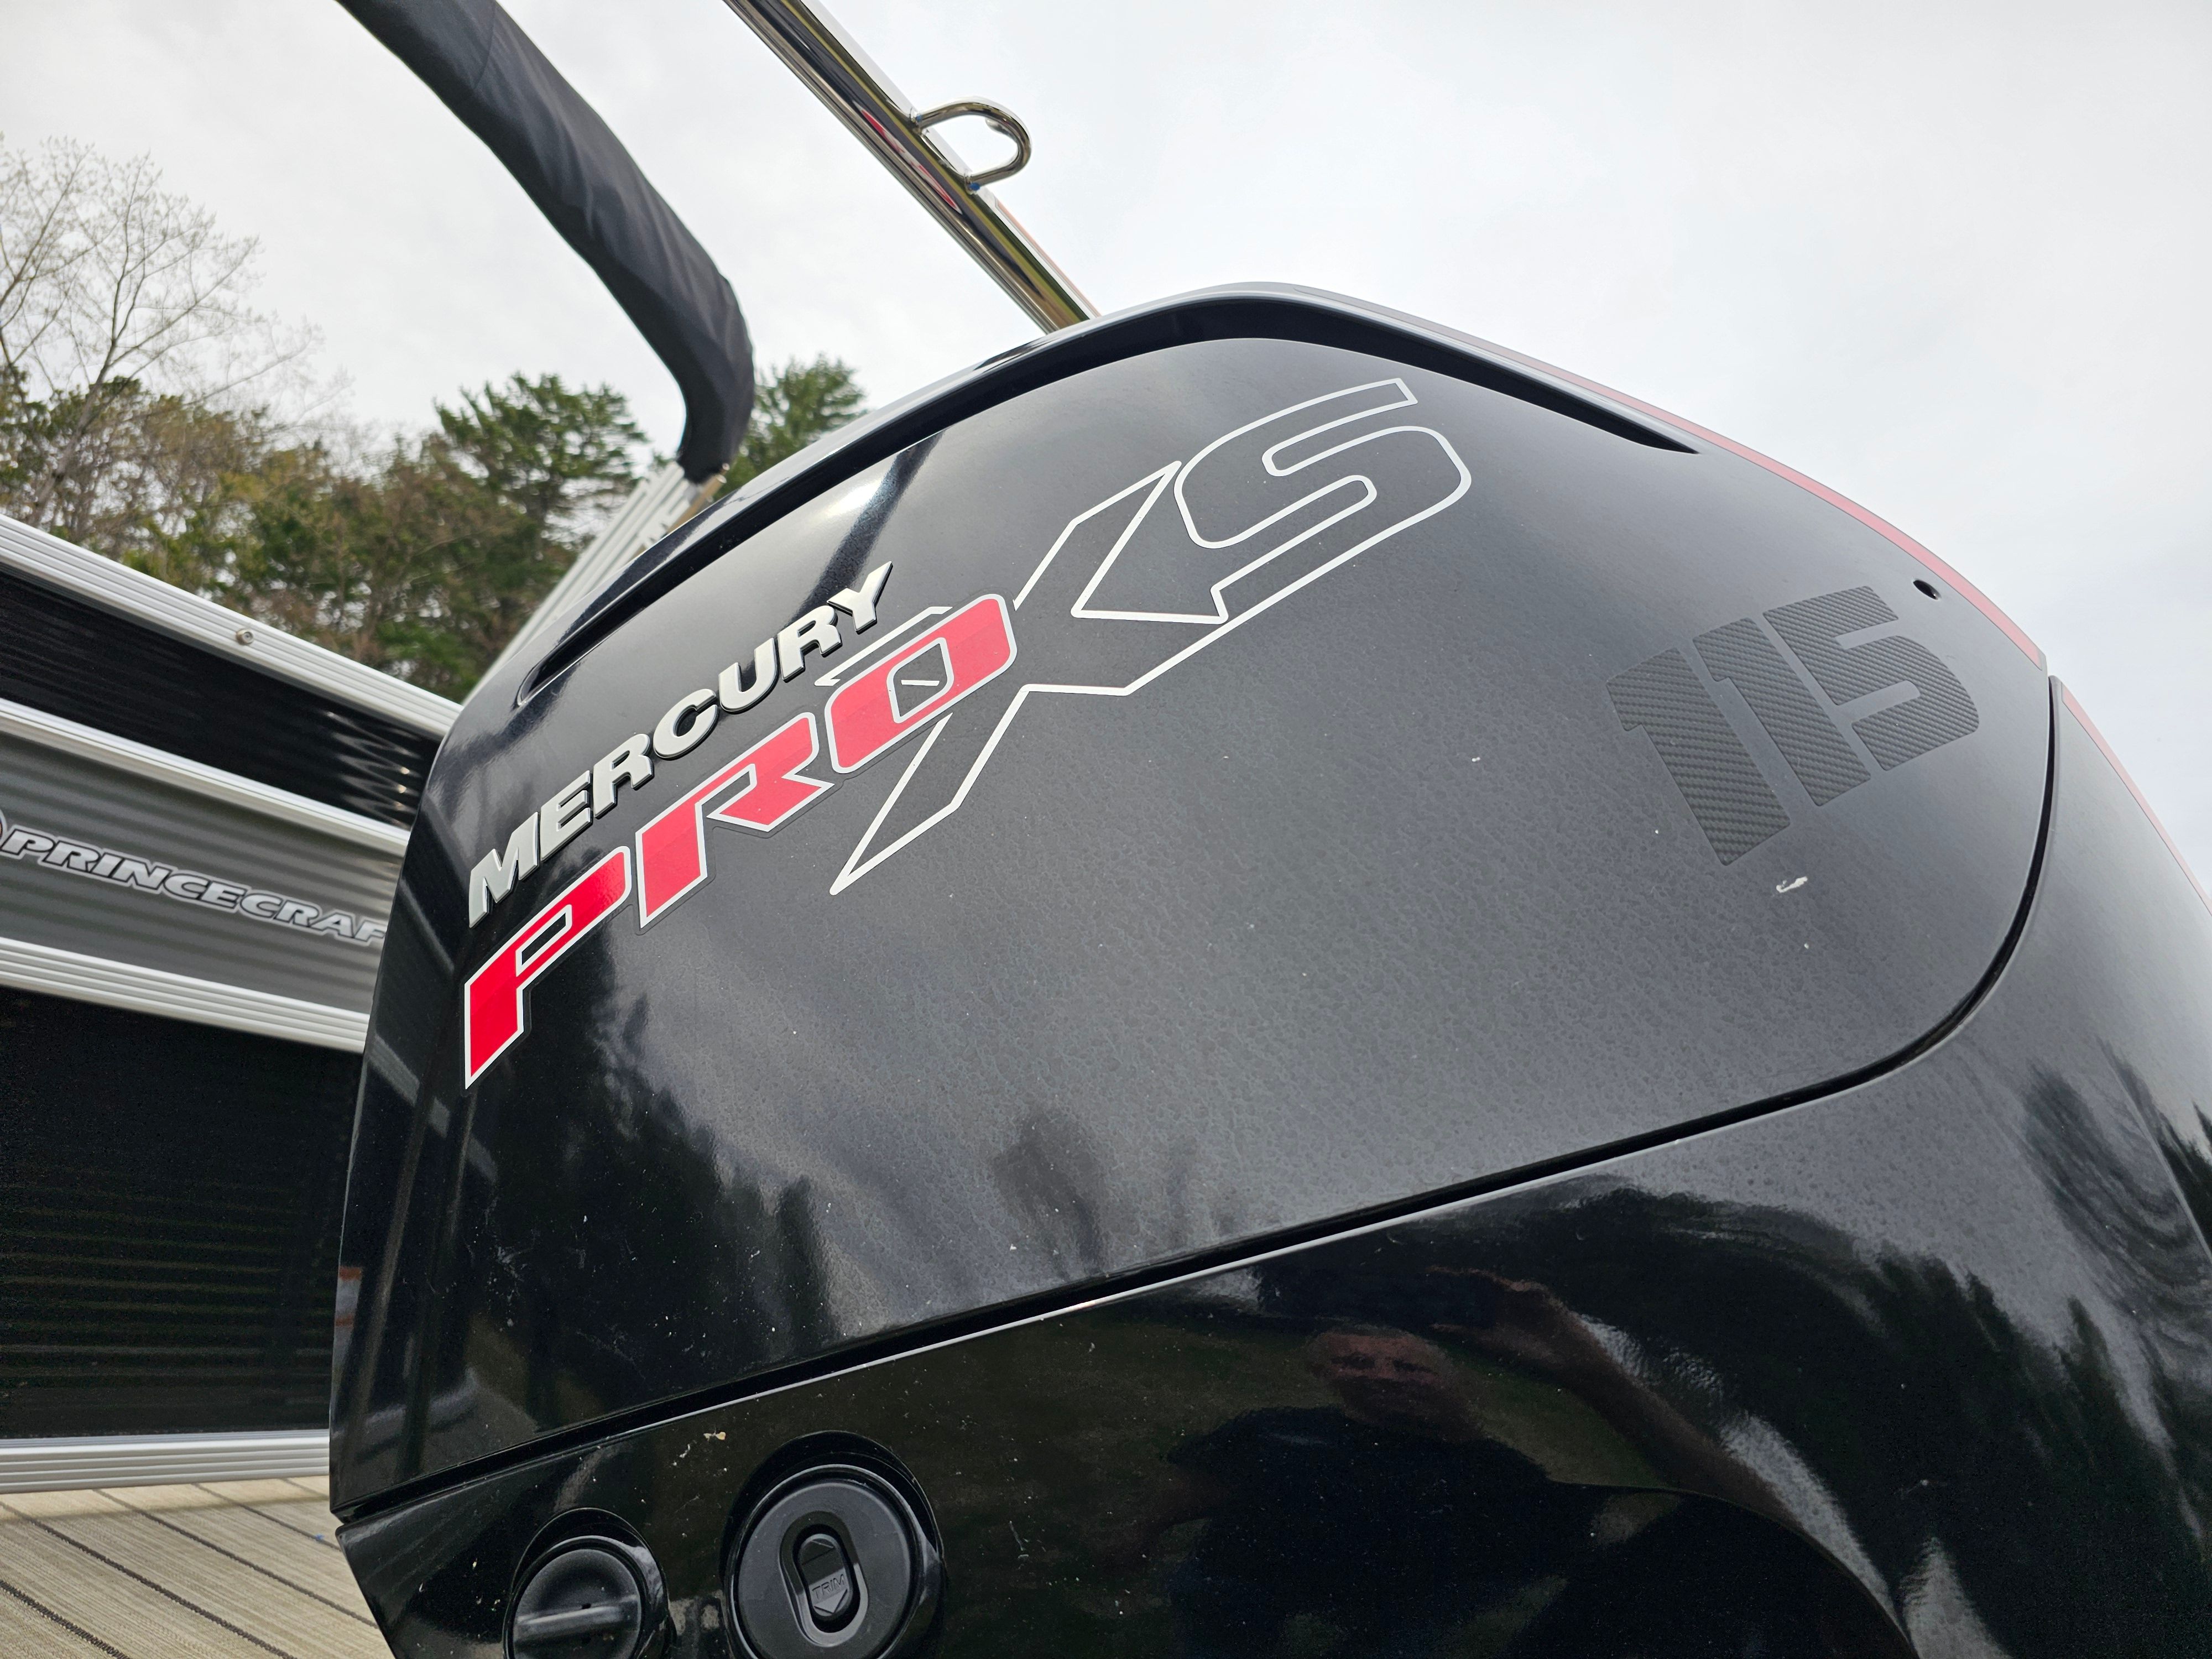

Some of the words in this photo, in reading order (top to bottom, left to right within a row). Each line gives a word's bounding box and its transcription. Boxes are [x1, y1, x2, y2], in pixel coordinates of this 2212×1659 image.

[464, 593, 1018, 1089] PRO
[814, 378, 1472, 896] XS
[469, 561, 893, 927] MERCURY
[1605, 586, 1980, 866] 115
[812, 1573, 848, 1600] TRIM
